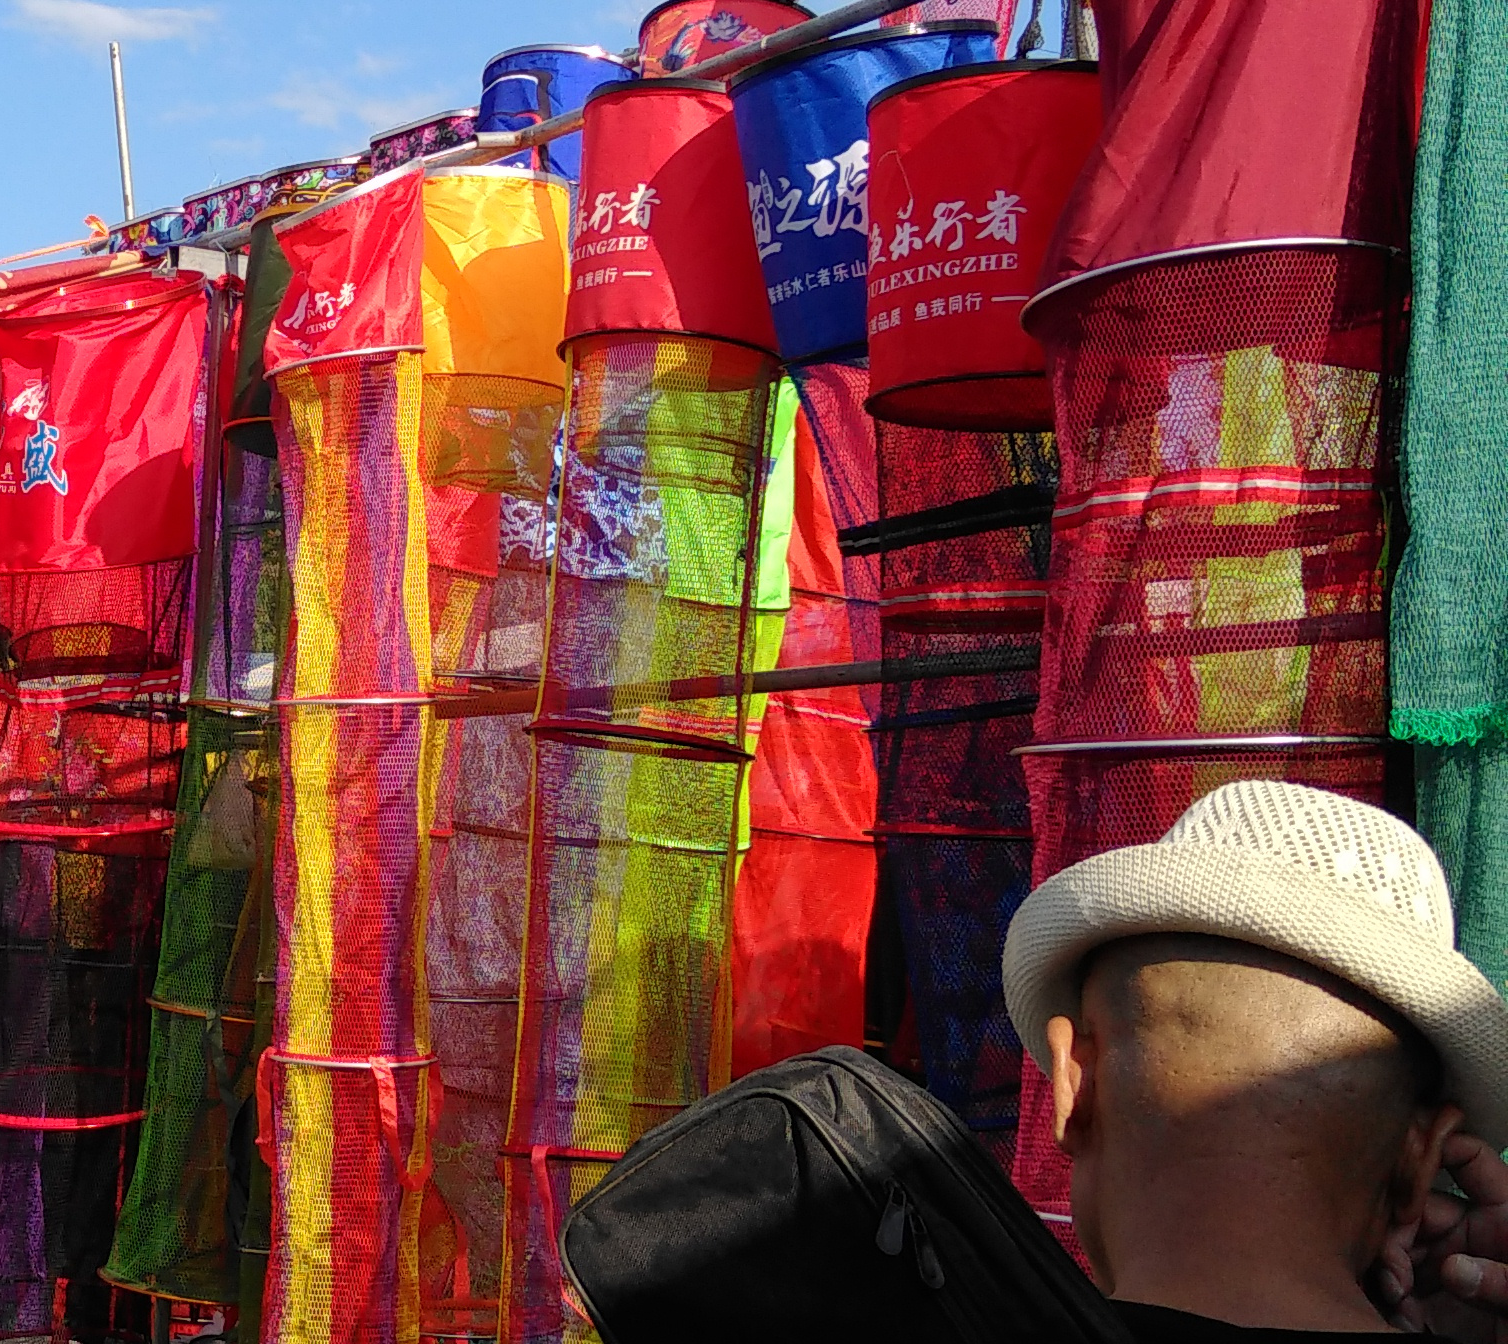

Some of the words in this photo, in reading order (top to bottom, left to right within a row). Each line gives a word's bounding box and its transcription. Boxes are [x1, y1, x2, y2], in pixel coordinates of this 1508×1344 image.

[868, 253, 1018, 299] ULEXINGZHE
[914, 292, 982, 321] 鱼我同行
